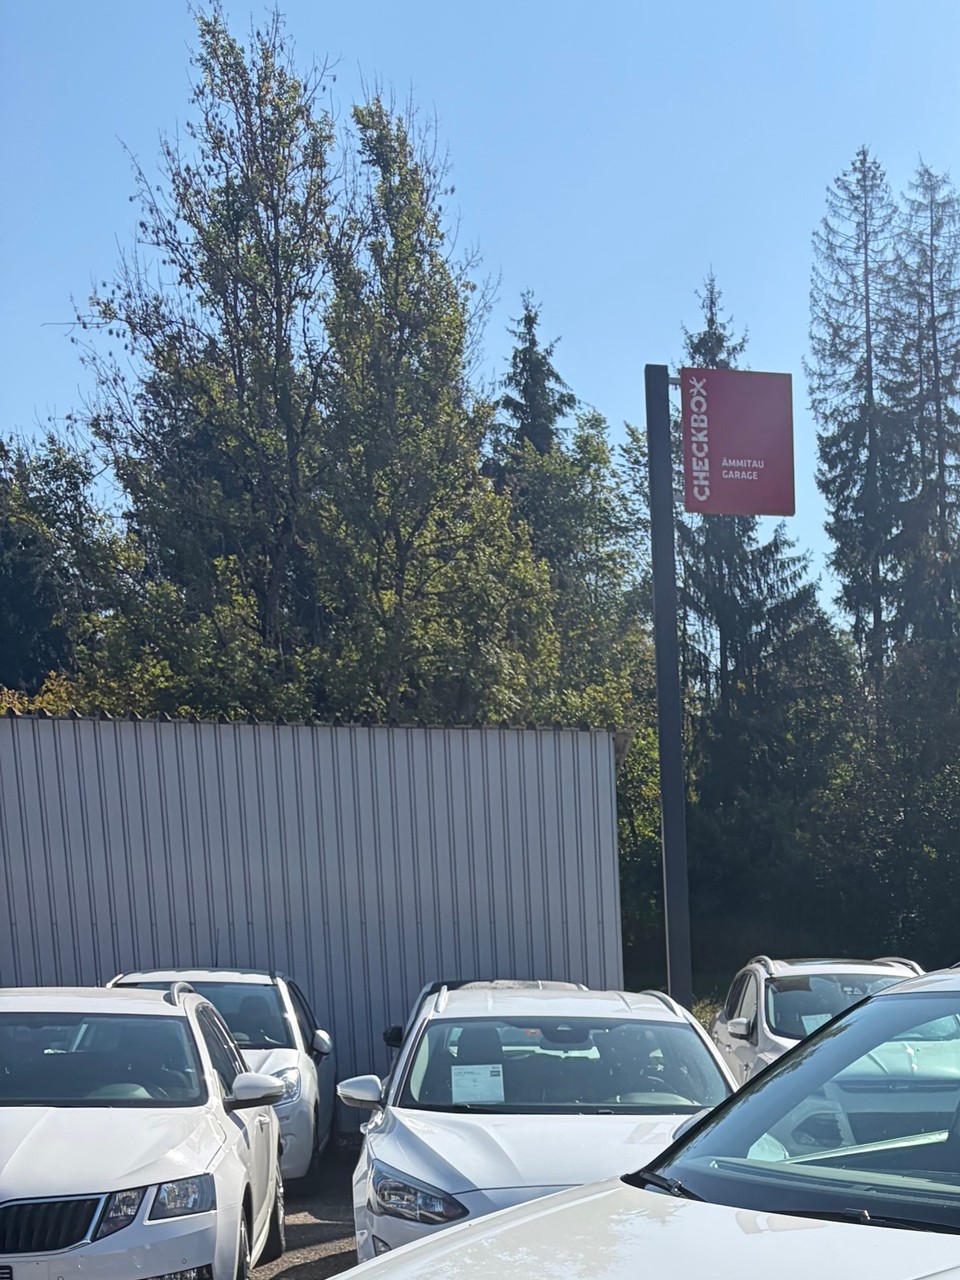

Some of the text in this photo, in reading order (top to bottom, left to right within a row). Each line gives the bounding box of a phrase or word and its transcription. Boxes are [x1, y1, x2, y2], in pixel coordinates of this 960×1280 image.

[689, 376, 711, 501] CHECKBOX
[722, 457, 765, 469] ÄMMITAU
[722, 470, 759, 480] GARAGE
